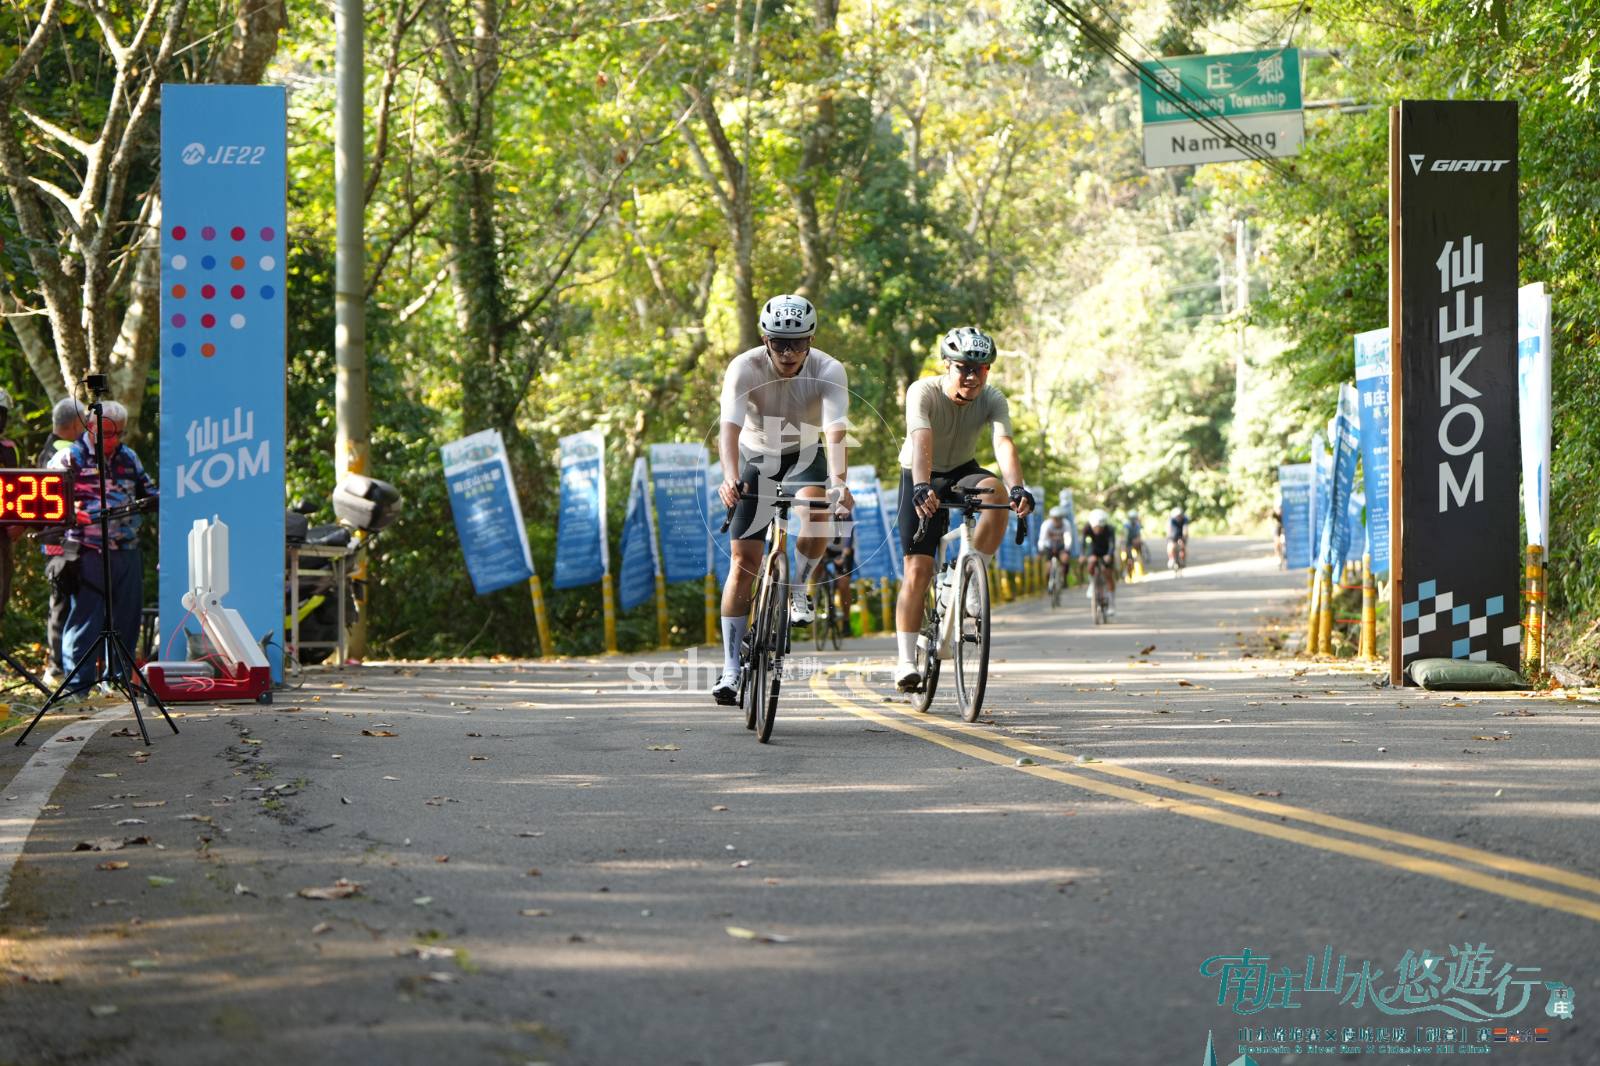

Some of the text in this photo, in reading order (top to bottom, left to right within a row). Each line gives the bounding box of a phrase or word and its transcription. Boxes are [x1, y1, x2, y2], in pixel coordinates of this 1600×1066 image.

[1228, 90, 1286, 109] Township
[207, 145, 266, 165] JE22
[1430, 159, 1511, 172] GIANT
[1436, 234, 1484, 513] 仙山 KOM
[185, 406, 254, 457] 仙山
[176, 439, 270, 498] KOM
[0, 476, 63, 519] :25
